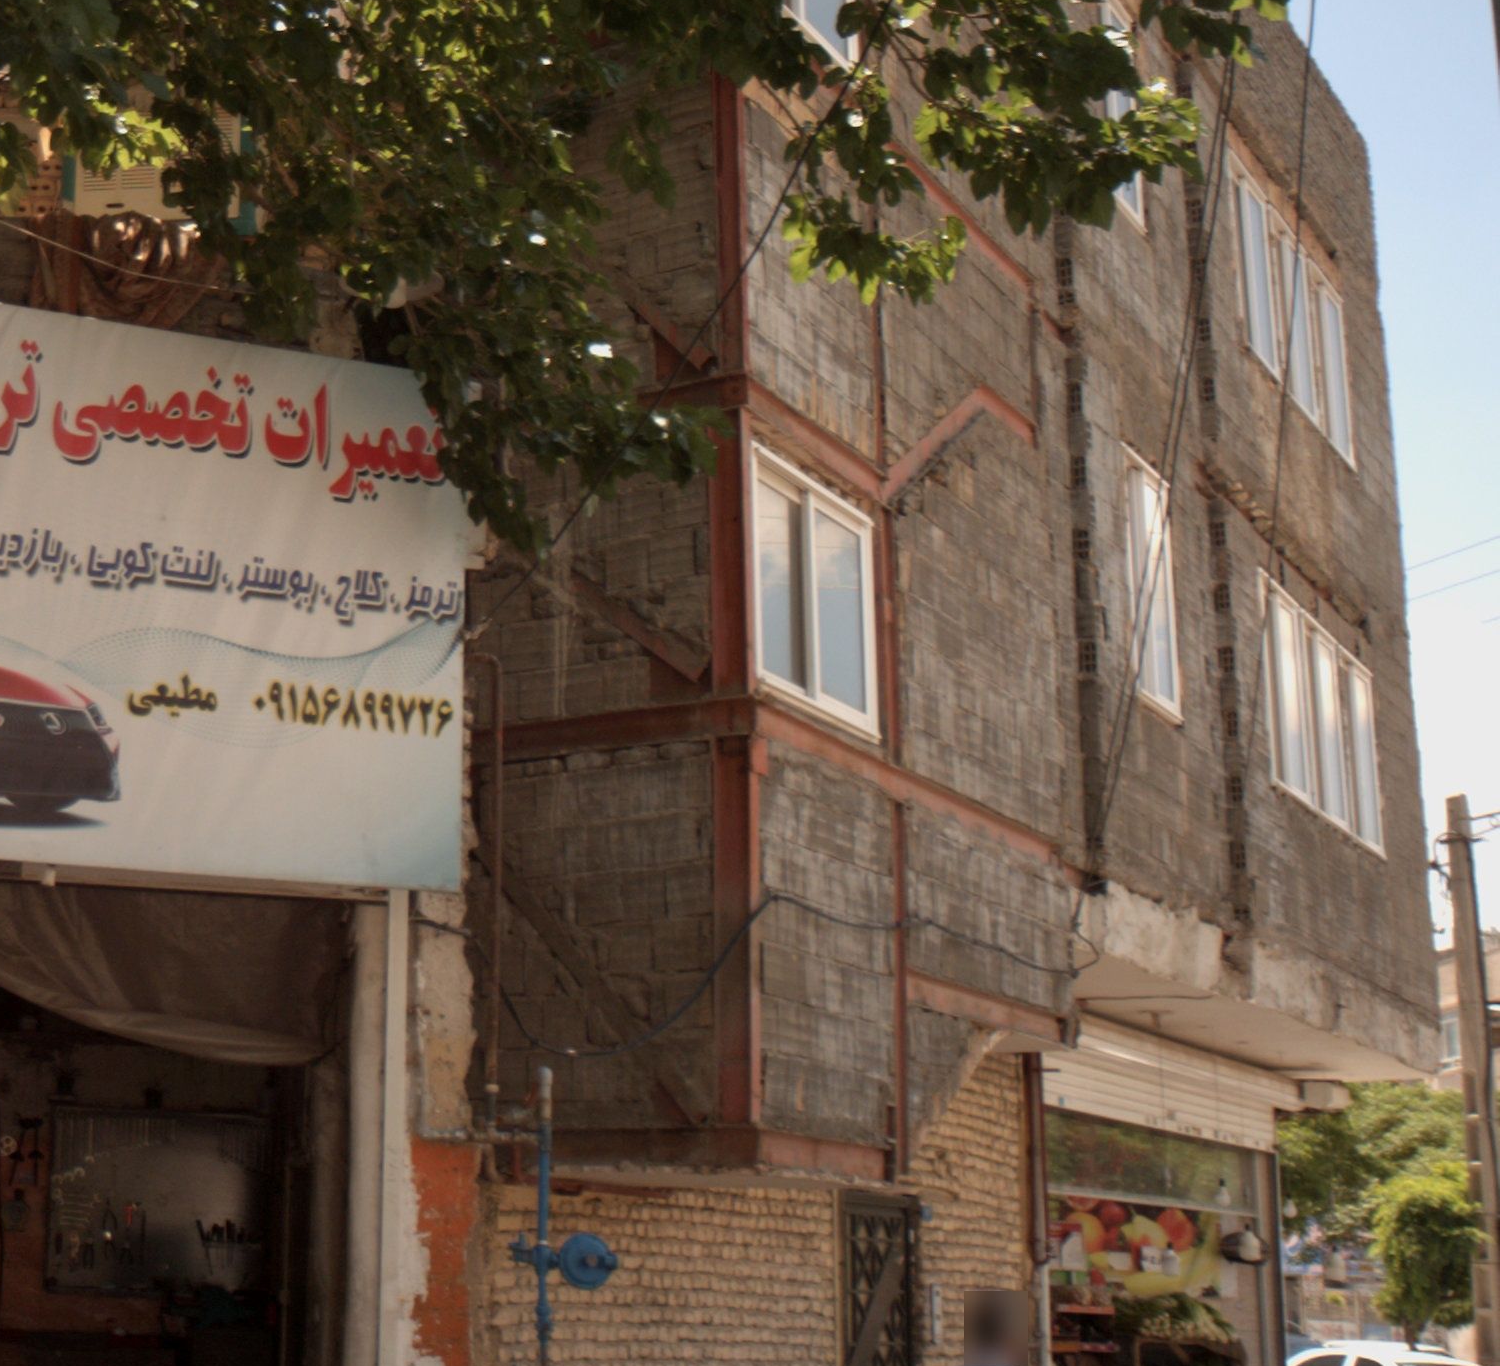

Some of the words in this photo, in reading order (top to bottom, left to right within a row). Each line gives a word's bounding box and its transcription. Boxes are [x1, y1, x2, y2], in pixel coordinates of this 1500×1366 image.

[52, 366, 254, 464] تخصصی
[87, 541, 158, 586] کوبی
[160, 545, 218, 588] لنت
[237, 556, 320, 611] بوستر
[404, 576, 462, 620] ترمز
